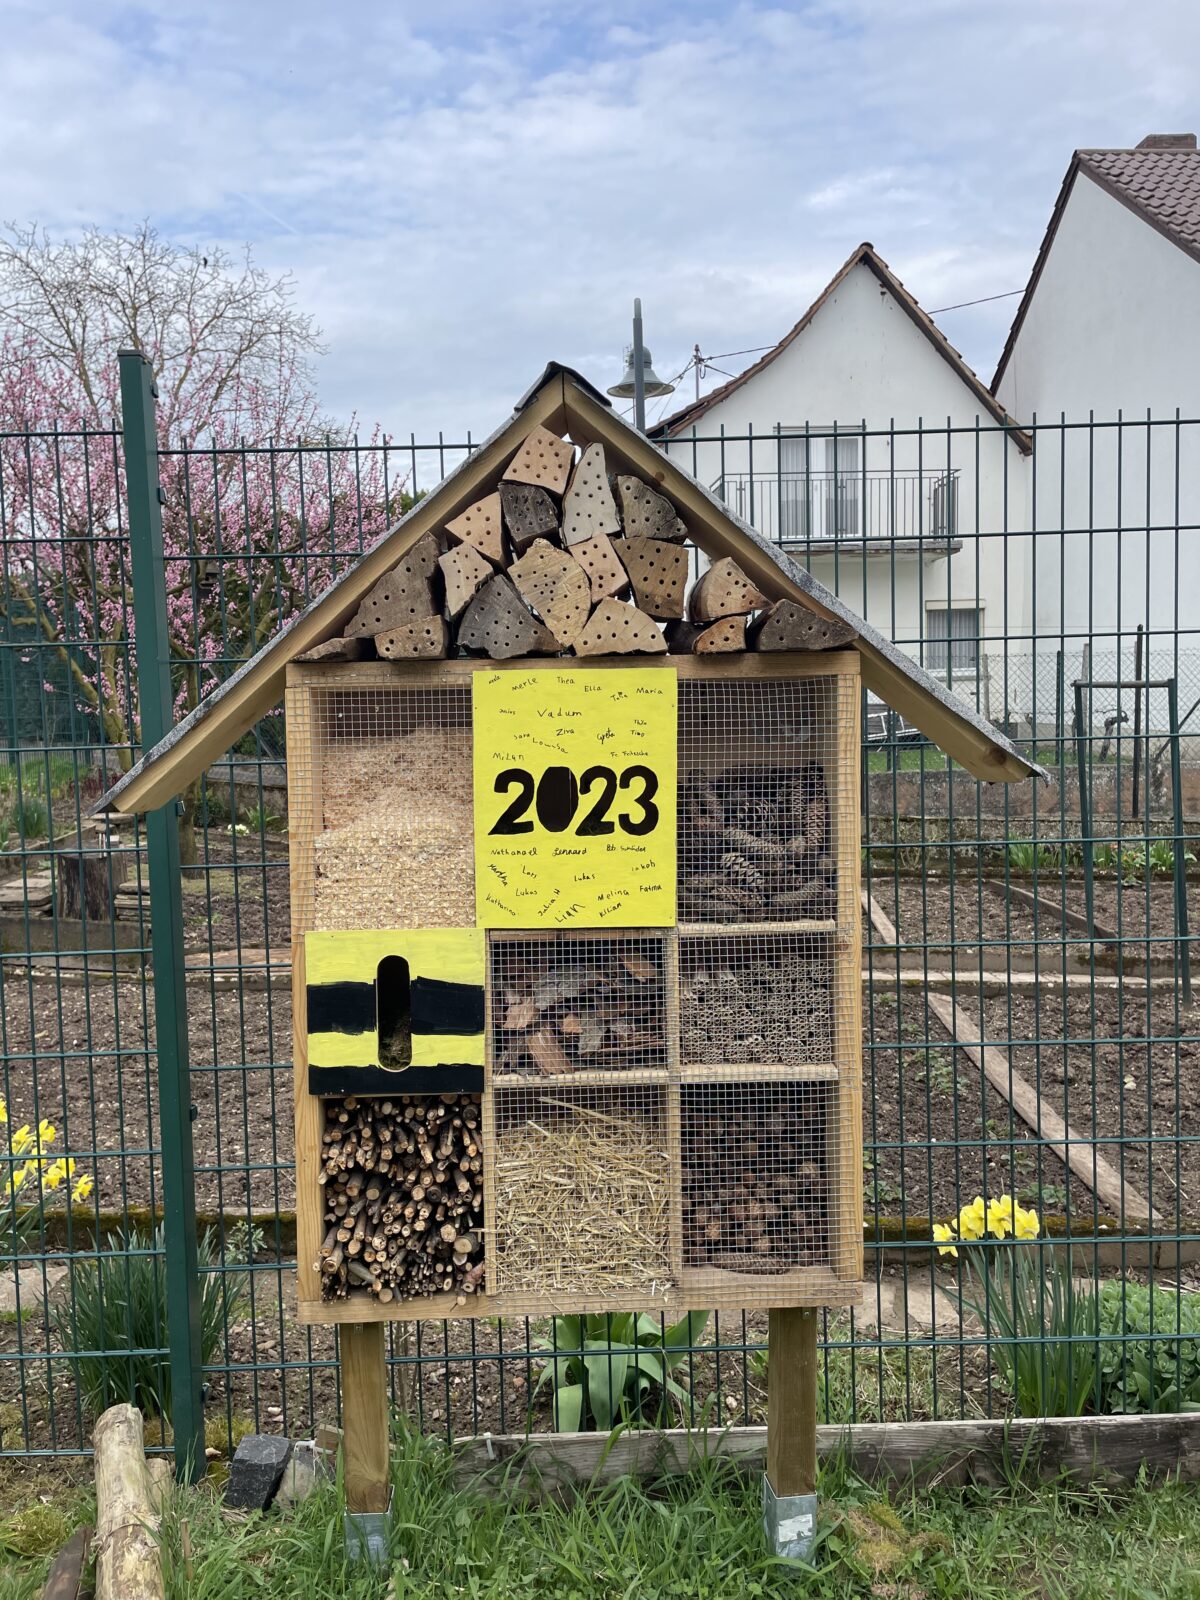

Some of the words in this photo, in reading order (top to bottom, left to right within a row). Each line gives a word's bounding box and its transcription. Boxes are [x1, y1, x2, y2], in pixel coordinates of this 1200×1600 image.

[556, 676, 575, 685] Thea
[584, 685, 603, 693] Ella
[635, 687, 664, 695] Maria
[596, 727, 616, 745] Greta
[492, 752, 525, 762] Milan
[488, 765, 659, 836] 2023
[573, 872, 596, 883] Lukas
[515, 887, 538, 897] Lukas
[597, 889, 630, 902] Melina
[554, 902, 586, 923] Lian
